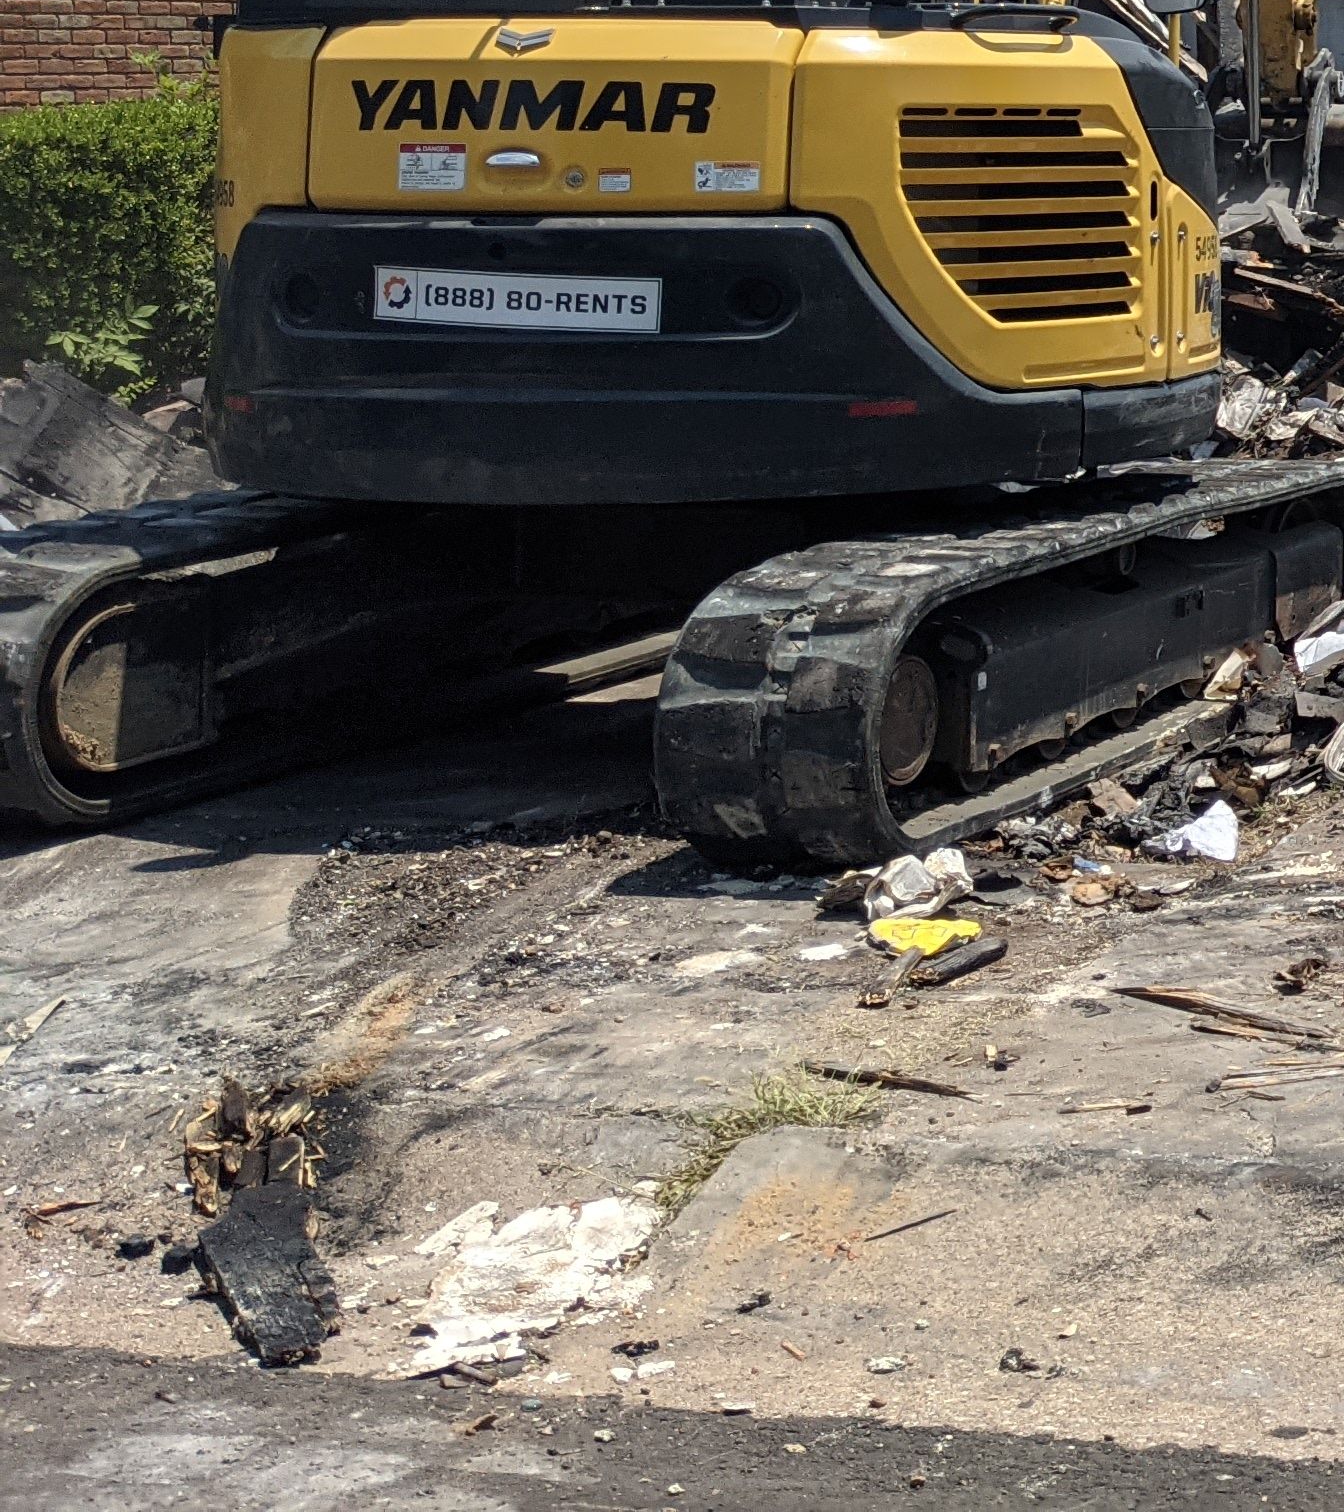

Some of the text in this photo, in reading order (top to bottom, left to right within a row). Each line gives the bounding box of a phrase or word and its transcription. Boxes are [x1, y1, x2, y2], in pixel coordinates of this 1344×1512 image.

[351, 79, 716, 133] YANMAR
[422, 145, 450, 153] DANGER
[424, 284, 648, 315] (888) 80-RENTS
